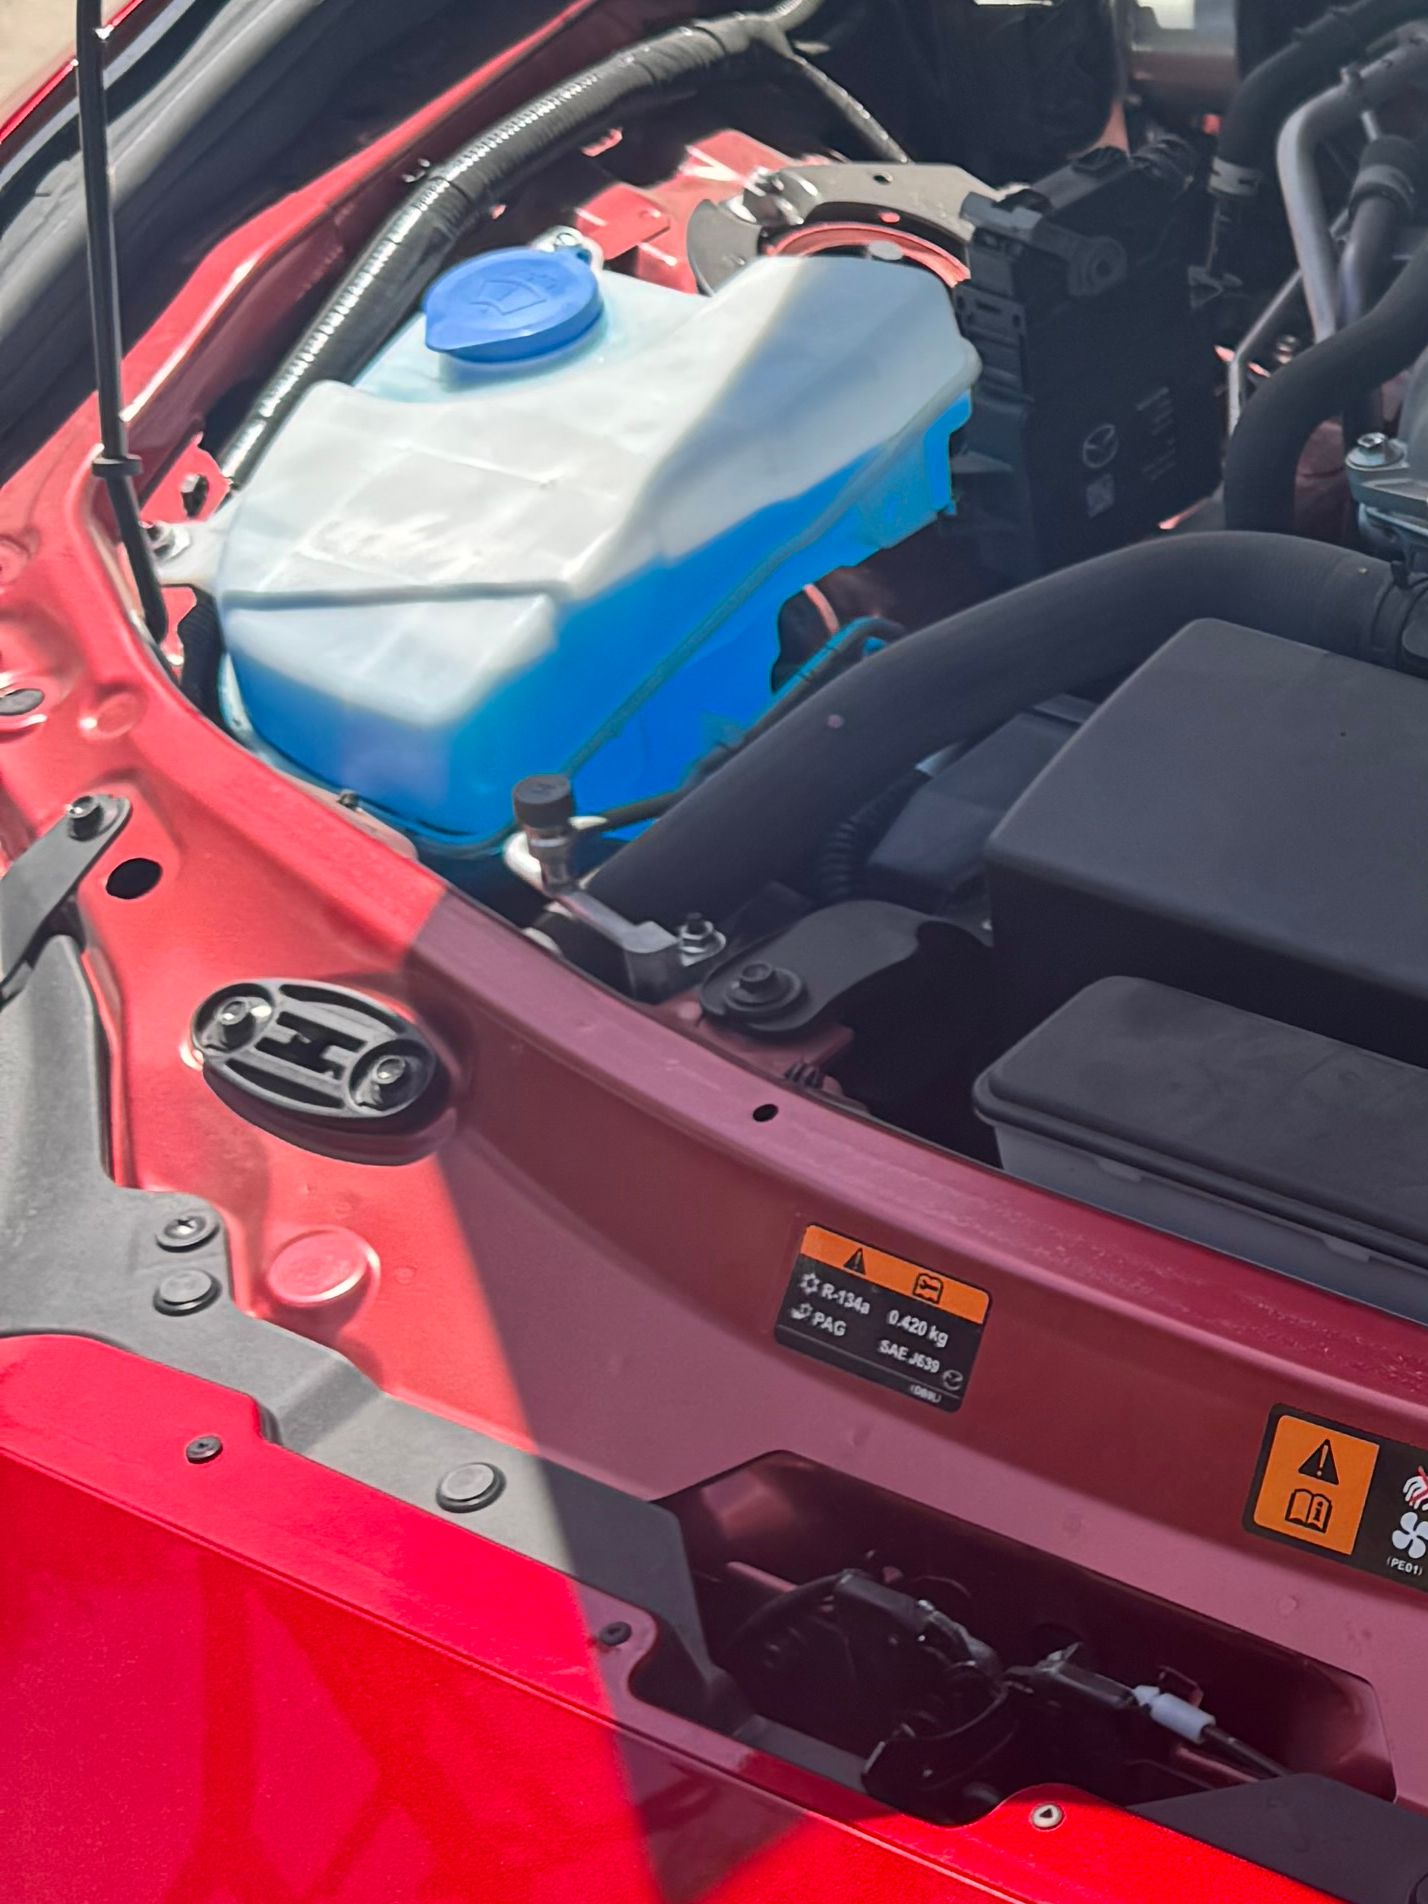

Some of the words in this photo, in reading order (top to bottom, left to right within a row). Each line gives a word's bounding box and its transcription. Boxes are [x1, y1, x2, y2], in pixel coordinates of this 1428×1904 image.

[812, 1311, 847, 1336] PAG
[878, 1339, 908, 1361] SAE
[820, 1283, 870, 1315] R-134a
[888, 1309, 927, 1337] 0.420
[928, 1325, 949, 1348] kg
[1386, 1557, 1424, 1576] (PE01)
